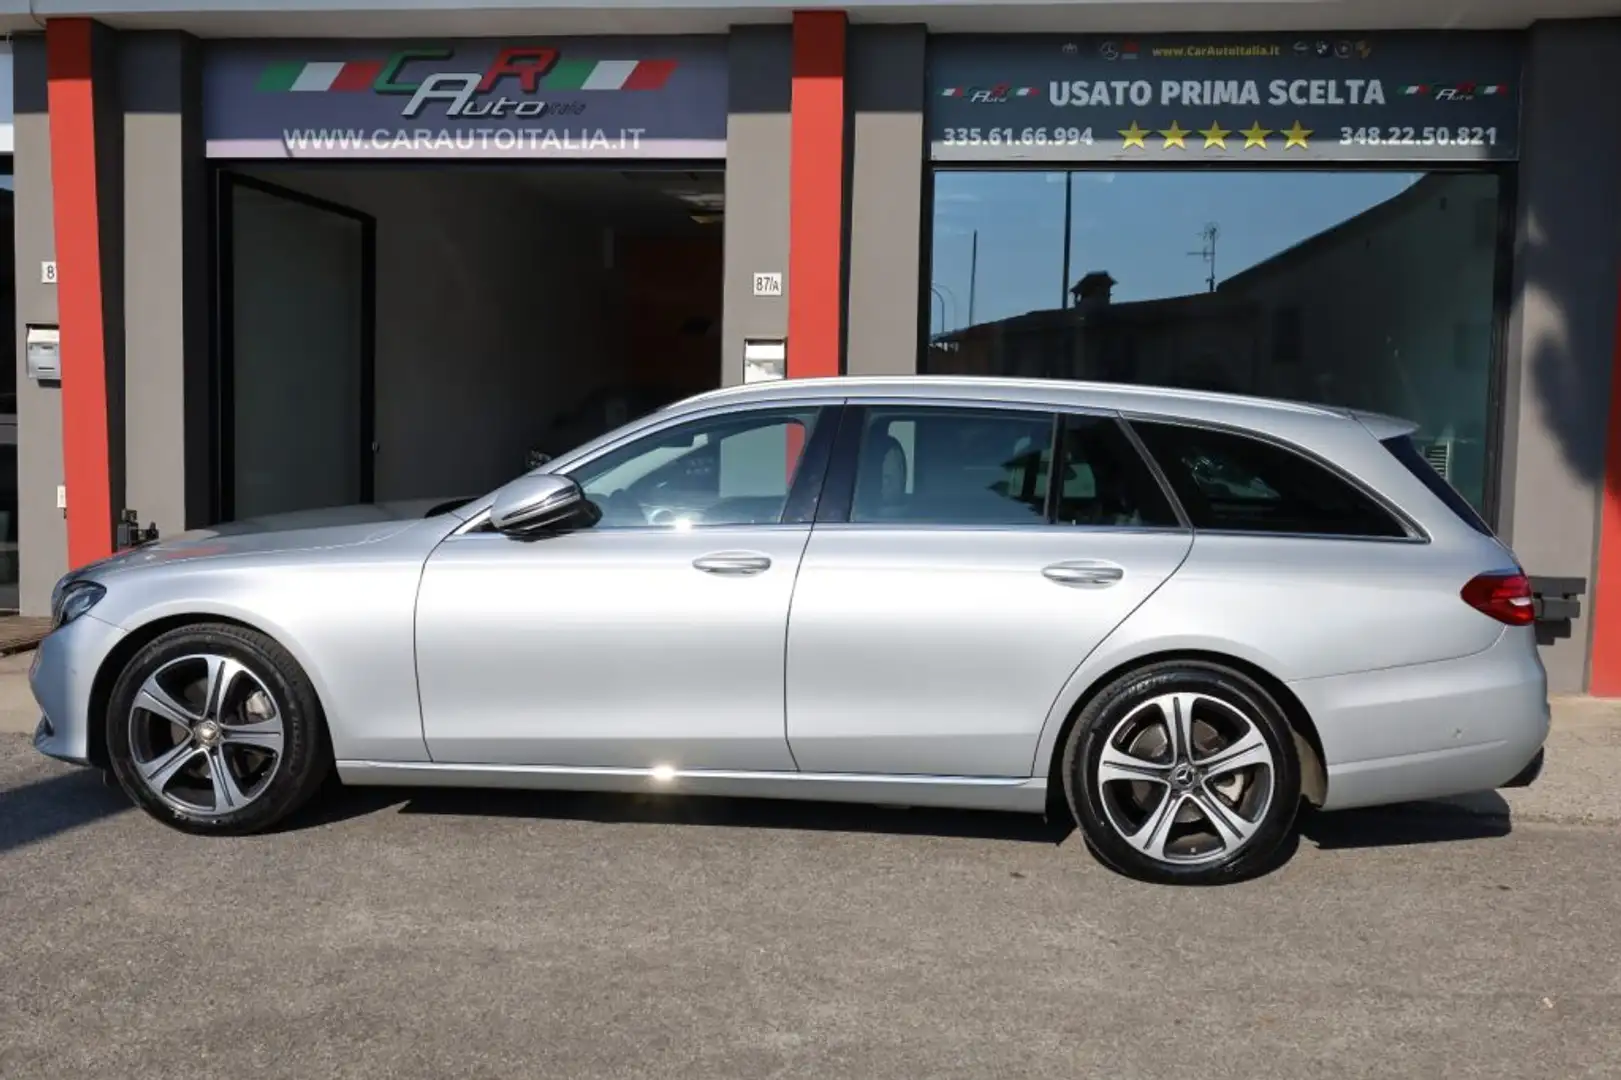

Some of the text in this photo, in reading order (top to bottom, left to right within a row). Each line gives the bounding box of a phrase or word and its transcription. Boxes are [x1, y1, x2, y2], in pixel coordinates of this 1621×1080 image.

[1049, 79, 1386, 106] USATO PRIMA SCELTA
[283, 128, 646, 151] WWW.CARAUTOITALIA.IT
[942, 126, 1095, 147] 335.61.66.994
[1339, 125, 1498, 146] 348.22.50.821
[756, 276, 779, 291] 87/A
